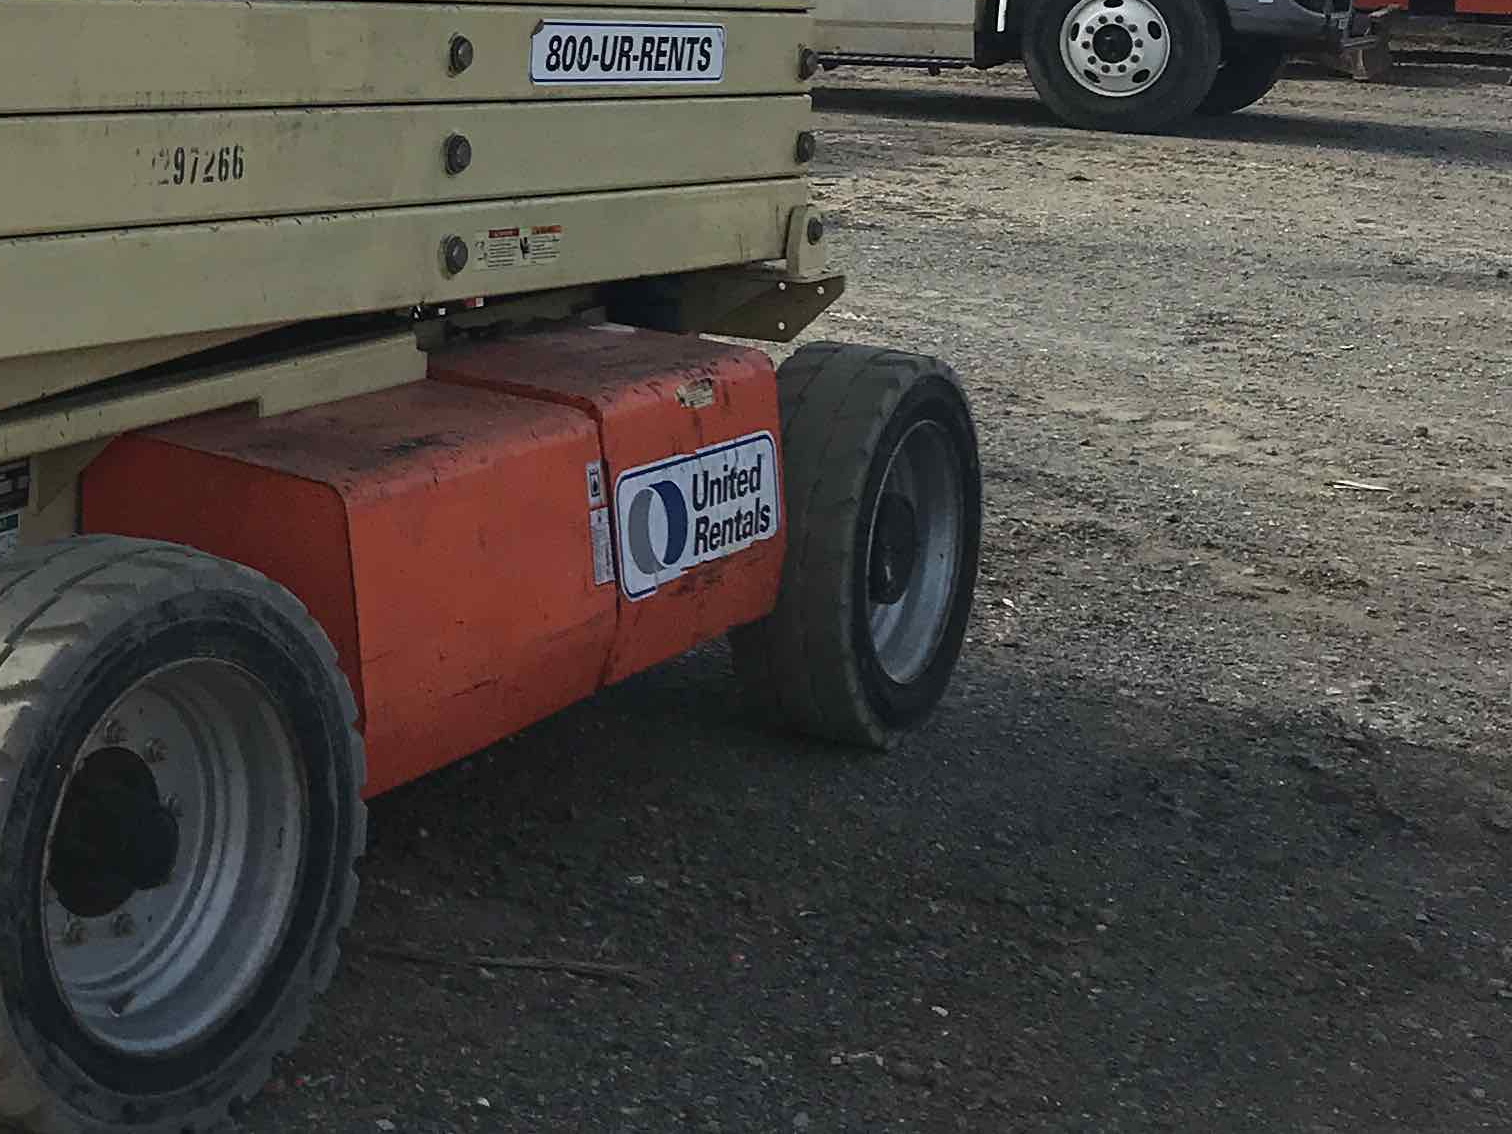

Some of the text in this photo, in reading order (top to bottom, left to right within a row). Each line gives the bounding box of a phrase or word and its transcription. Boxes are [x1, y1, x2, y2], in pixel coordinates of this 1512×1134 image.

[546, 35, 712, 71] 800-UR-RENTS
[693, 454, 762, 512] United
[693, 498, 771, 556] Rentals
